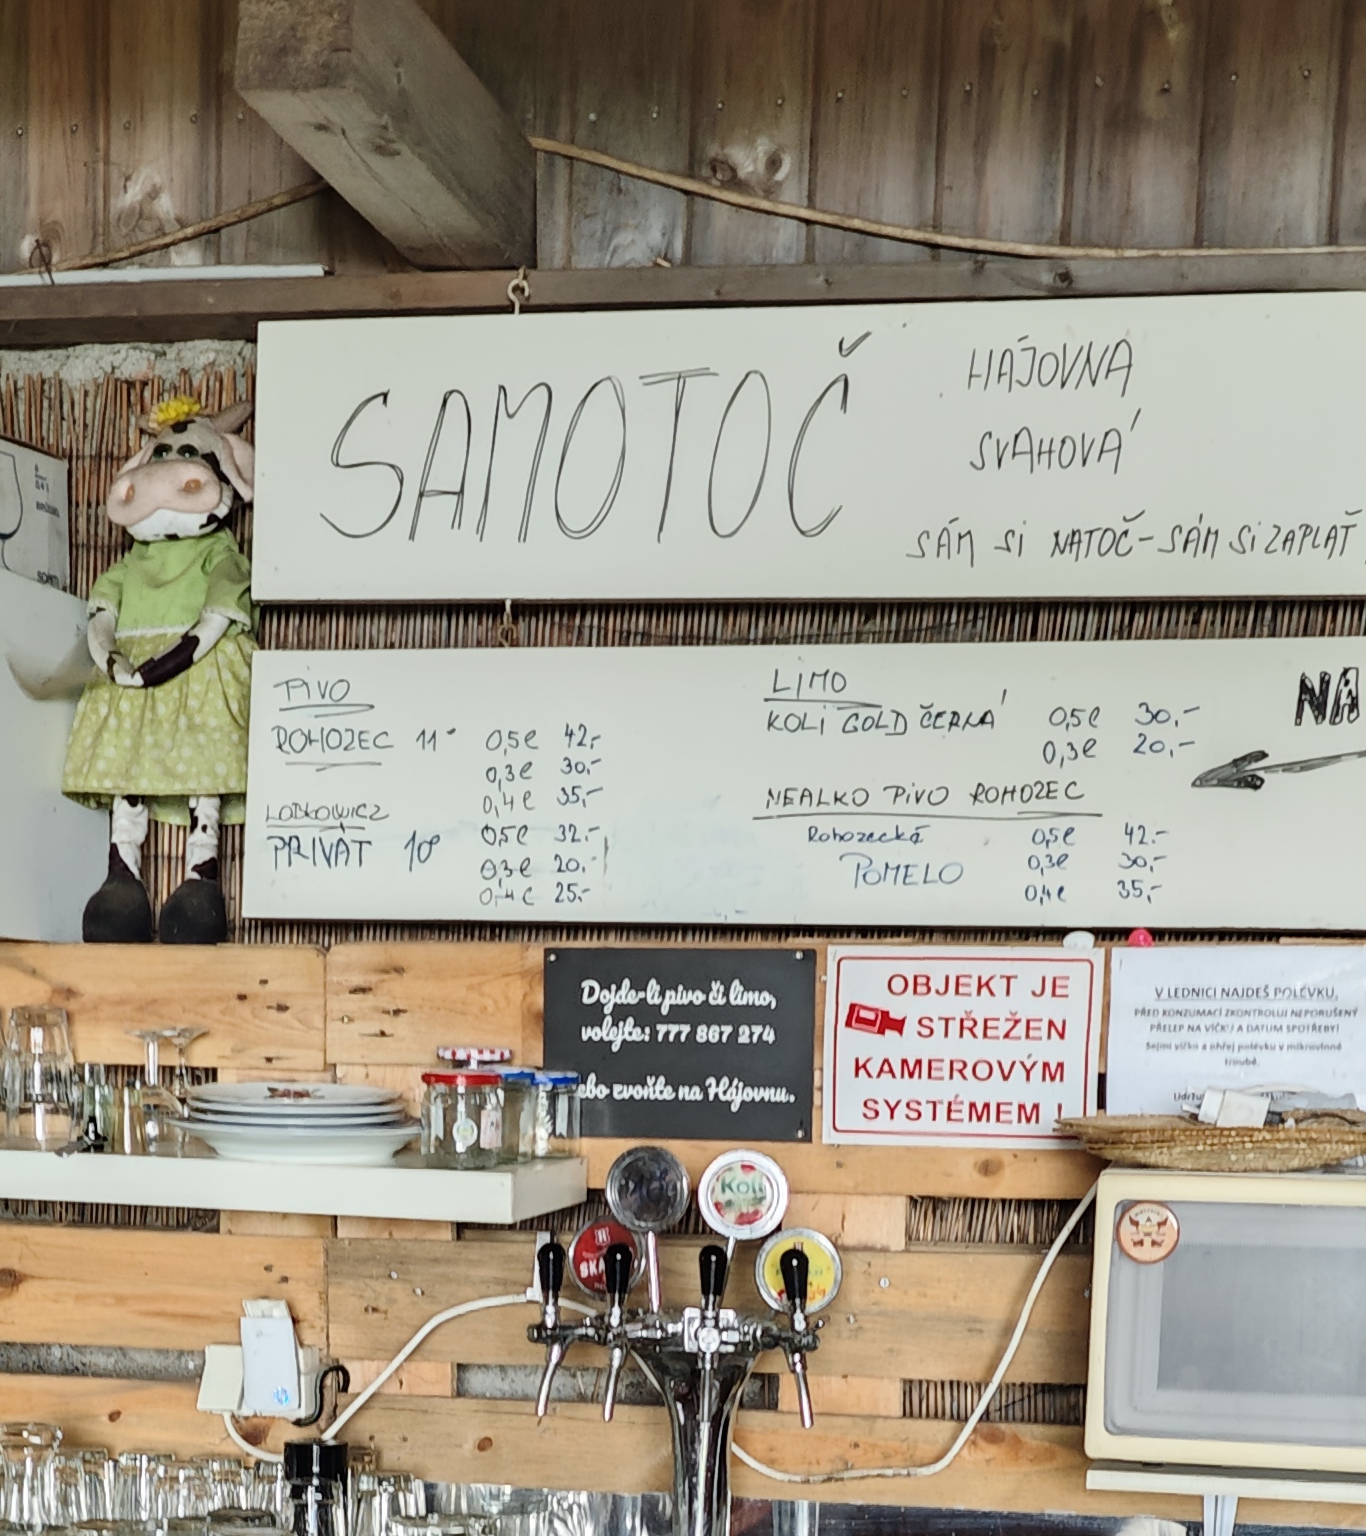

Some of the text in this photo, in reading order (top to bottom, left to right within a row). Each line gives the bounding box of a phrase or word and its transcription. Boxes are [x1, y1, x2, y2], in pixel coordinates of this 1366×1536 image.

[968, 335, 1133, 398] HÁJOVNA
[320, 332, 872, 542] SAMOTOČ
[969, 408, 1142, 475] SVAHOVÁ
[906, 517, 974, 568] SÁM
[773, 669, 847, 698] LIMO
[1295, 667, 1360, 726] NA
[765, 786, 870, 808] NEALKO
[808, 824, 931, 844] Rohozecká
[839, 852, 964, 889] POMELO
[580, 977, 777, 1016] Dojde-li pivo či limo,
[887, 973, 1070, 998] OBJEKT JE
[1155, 987, 1164, 998] V
[1167, 987, 1217, 998] LEDNICI
[1221, 984, 1269, 998] NAJDEŠ
[917, 1010, 1067, 1041] STŘEŽEN
[1135, 1007, 1159, 1018] PŘED
[1162, 1006, 1222, 1018] KONZUMACÍ
[581, 1015, 776, 1053] volejte: 777 867 274
[1150, 1024, 1184, 1033] PŘELEP
[1188, 1024, 1202, 1033] NA
[1237, 1024, 1243, 1033] A
[1247, 1024, 1283, 1033] DATUM
[854, 1053, 1065, 1083] KAMEROVÝM
[578, 1072, 796, 1113] ebo zvoňte na Hájovnu.
[862, 1094, 1040, 1125] SYSTÉMEM
